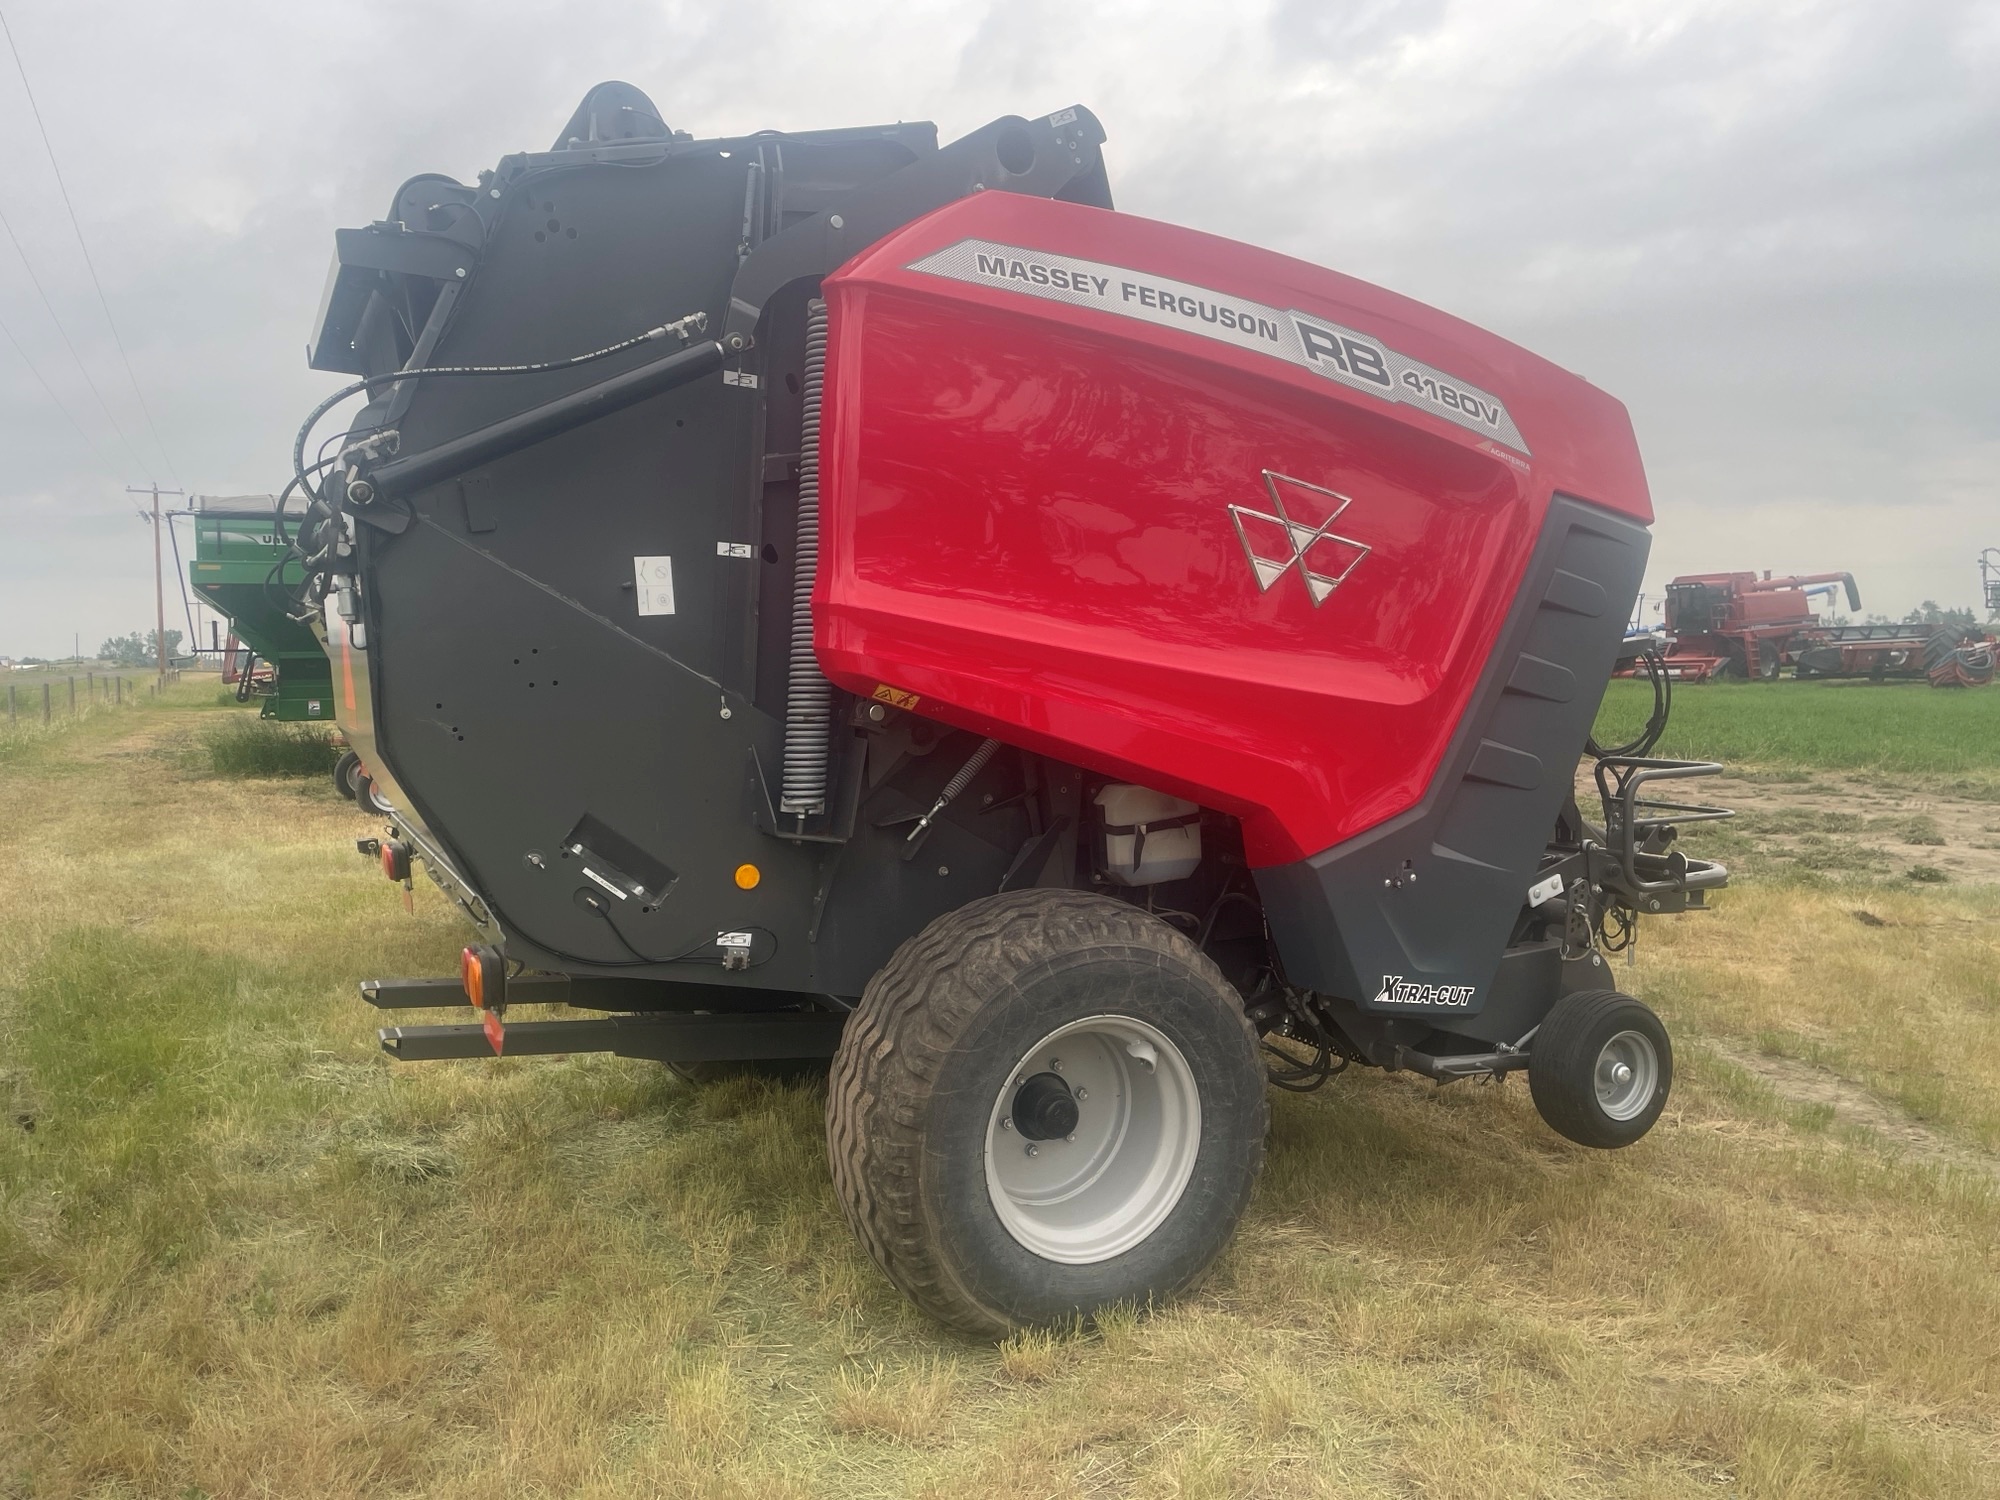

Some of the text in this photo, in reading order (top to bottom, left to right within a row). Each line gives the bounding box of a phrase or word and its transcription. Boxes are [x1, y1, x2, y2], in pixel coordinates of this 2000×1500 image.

[976, 253, 1503, 430] MASSEY FERGUSON RB 4180V
[1490, 447, 1531, 471] AGRITERRA
[1374, 975, 1476, 1007] XTRA-CUT
